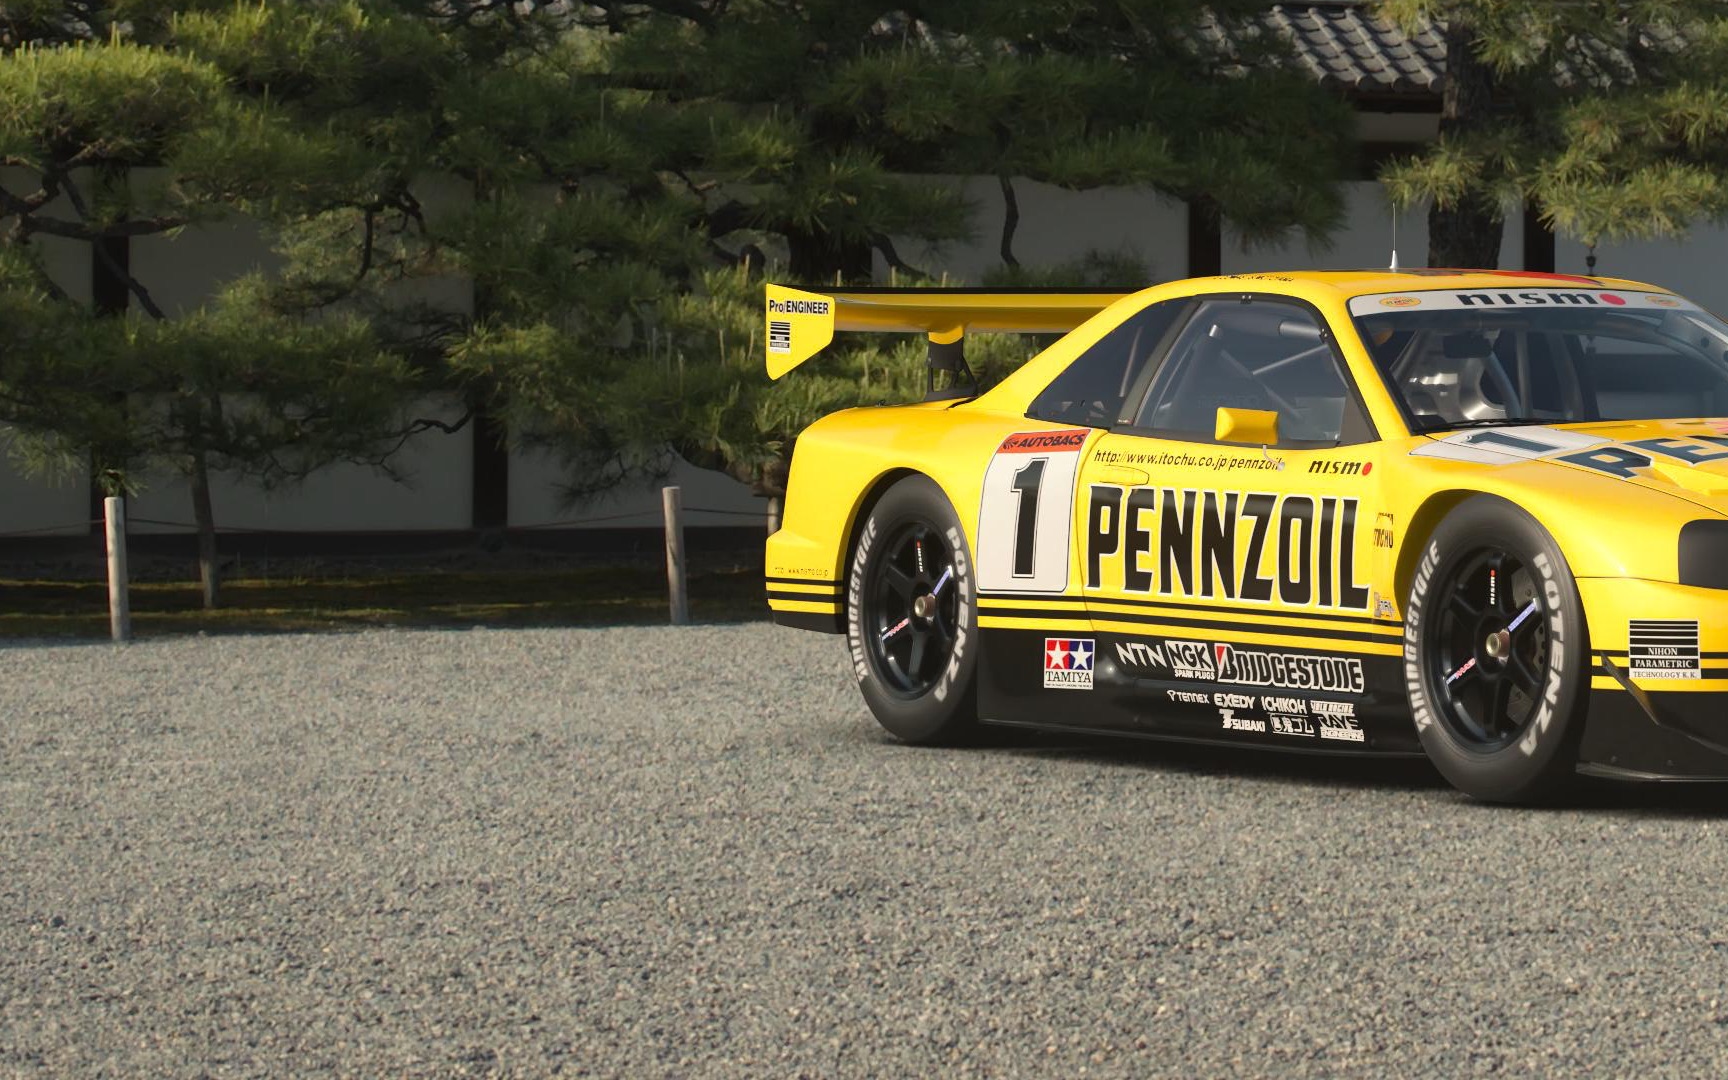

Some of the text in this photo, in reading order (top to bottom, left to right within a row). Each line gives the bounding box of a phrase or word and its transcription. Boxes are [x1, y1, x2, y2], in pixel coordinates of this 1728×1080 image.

[769, 300, 829, 315] Pro/ENGINEER
[1018, 434, 1085, 448] AUTOBACS
[1010, 457, 1050, 578] 1
[1086, 484, 1371, 610] PENNZOIL
[934, 526, 969, 702] POTENZA
[1115, 642, 1168, 668] NTN
[1166, 642, 1213, 670] NGK
[1519, 552, 1564, 757] POTENZA
[1648, 647, 1678, 656] NIHON
[1214, 643, 1365, 693] BRIDGESTONE
[1635, 659, 1693, 668] PARAMETRIC
[1046, 671, 1091, 683] TAMIYA
[1174, 670, 1215, 680] SPARK PLUGS
[1633, 671, 1681, 679] TECHNOLOGY
[1177, 691, 1209, 704] TENNEX
[1213, 693, 1256, 709] EXEDY
[1261, 696, 1308, 715] ICHIKOH
[1219, 709, 1266, 732] TSUBAKI
